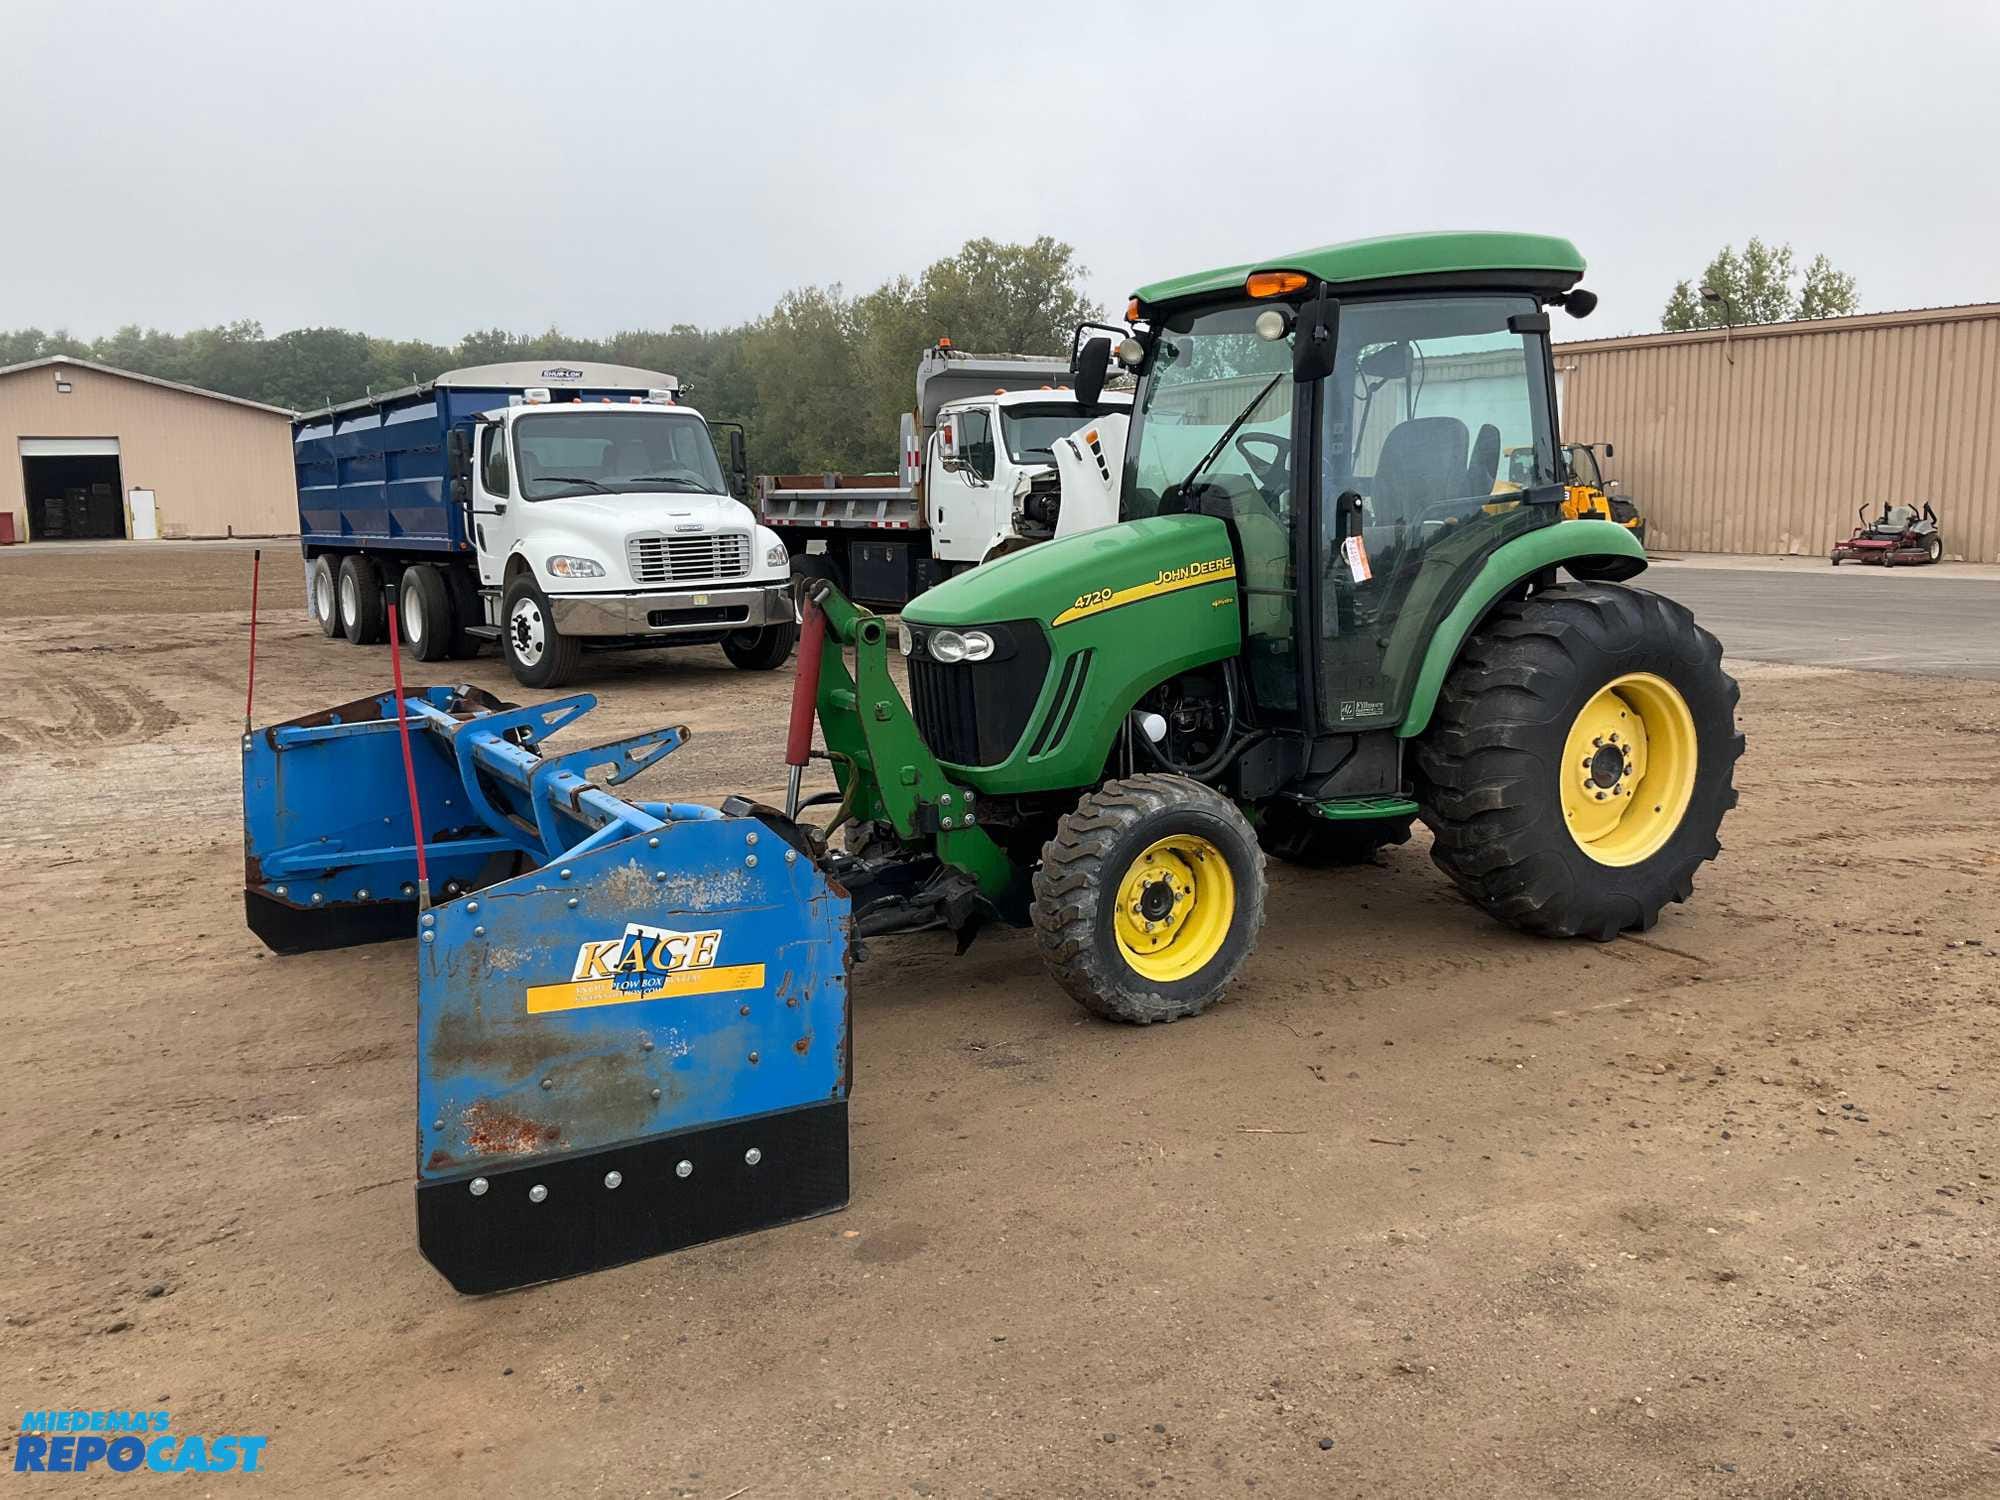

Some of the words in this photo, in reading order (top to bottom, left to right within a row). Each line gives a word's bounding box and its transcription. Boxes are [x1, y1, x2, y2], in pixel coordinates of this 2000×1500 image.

[1154, 567, 1189, 585] JOHN
[1190, 556, 1232, 577] DEERE
[1074, 588, 1112, 609] 4720
[576, 932, 719, 979] KAGE
[611, 980, 641, 991] PLOW
[642, 977, 663, 988] BOX
